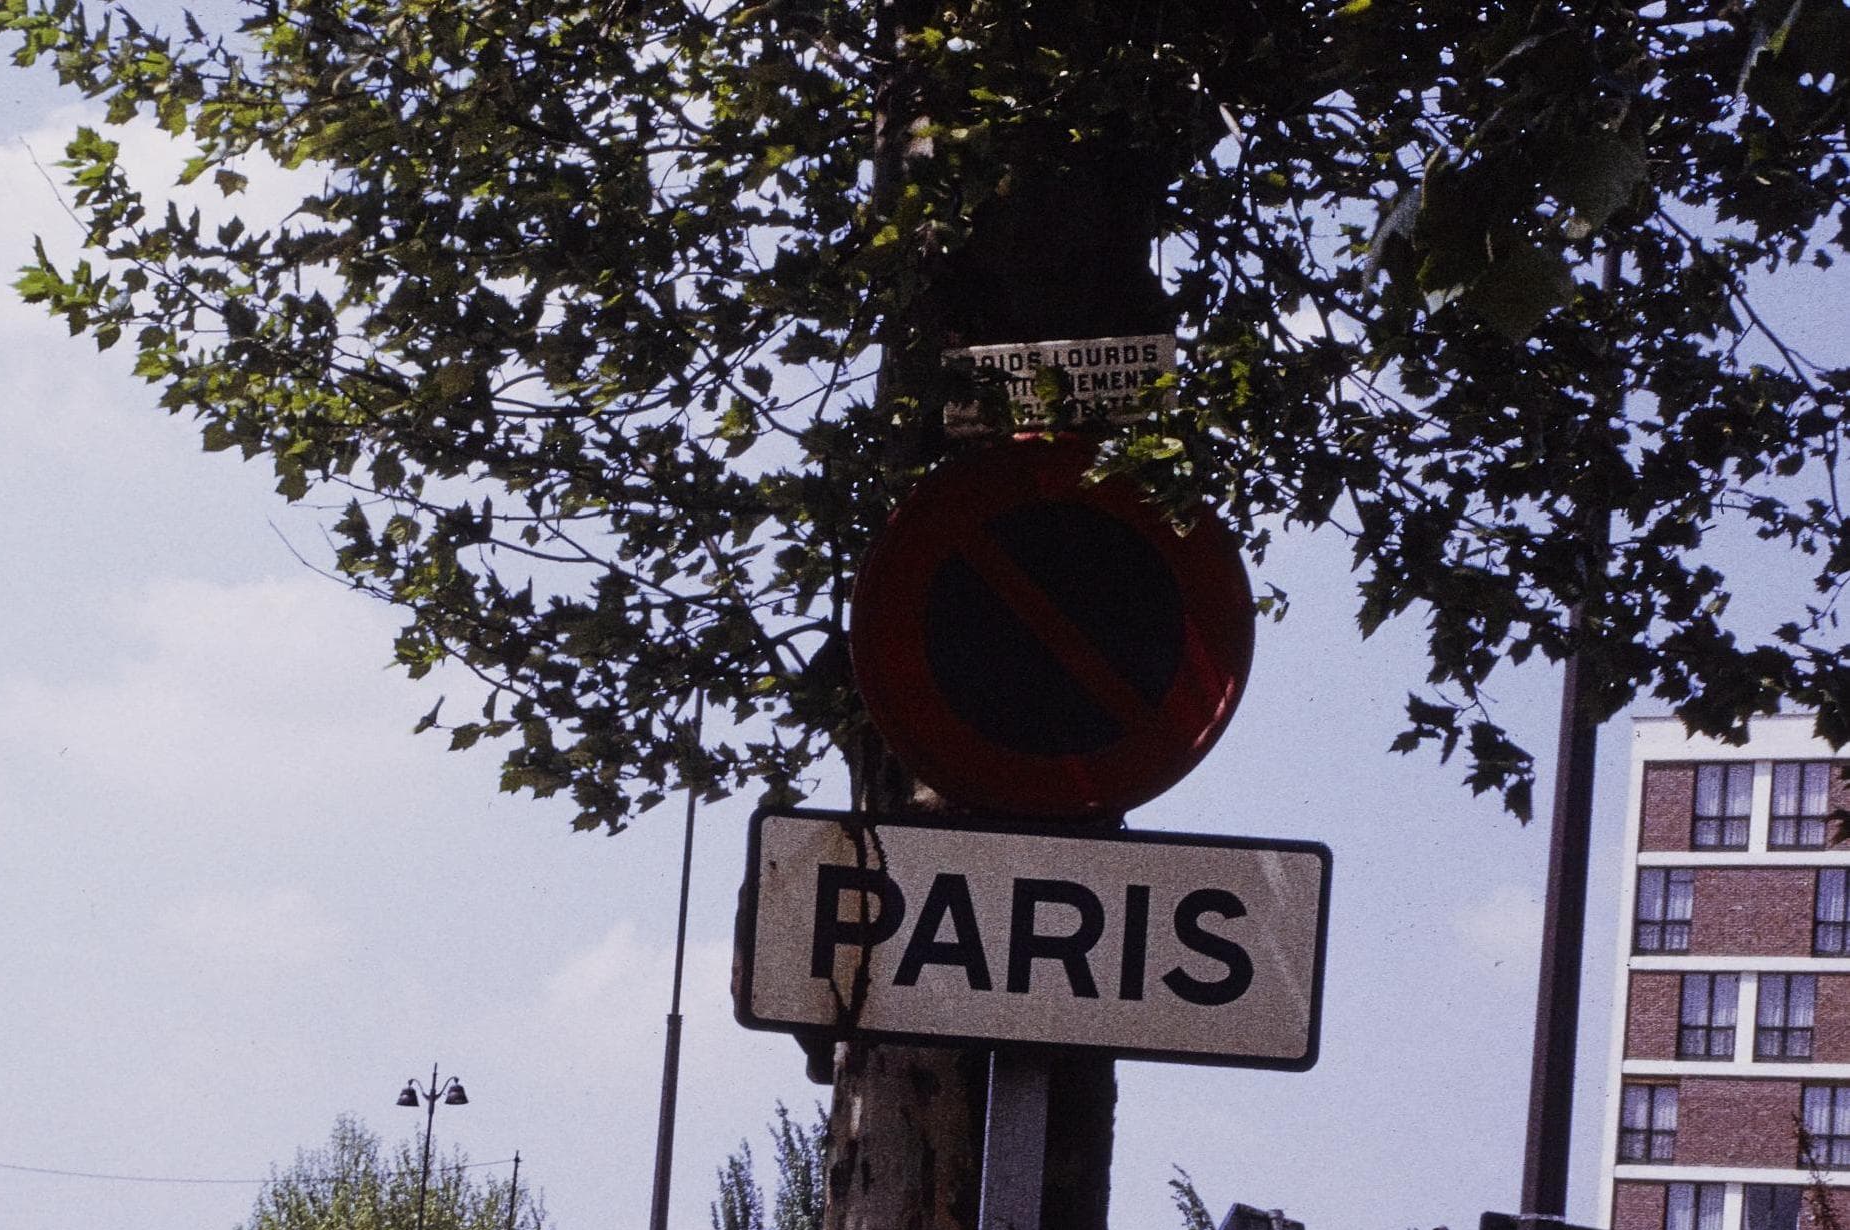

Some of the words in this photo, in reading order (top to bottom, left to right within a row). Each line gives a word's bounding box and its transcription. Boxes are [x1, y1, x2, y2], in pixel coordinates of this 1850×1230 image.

[965, 350, 1041, 373] OIDS
[1053, 344, 1158, 368] LOURDS
[810, 864, 1254, 1006] PARIS
